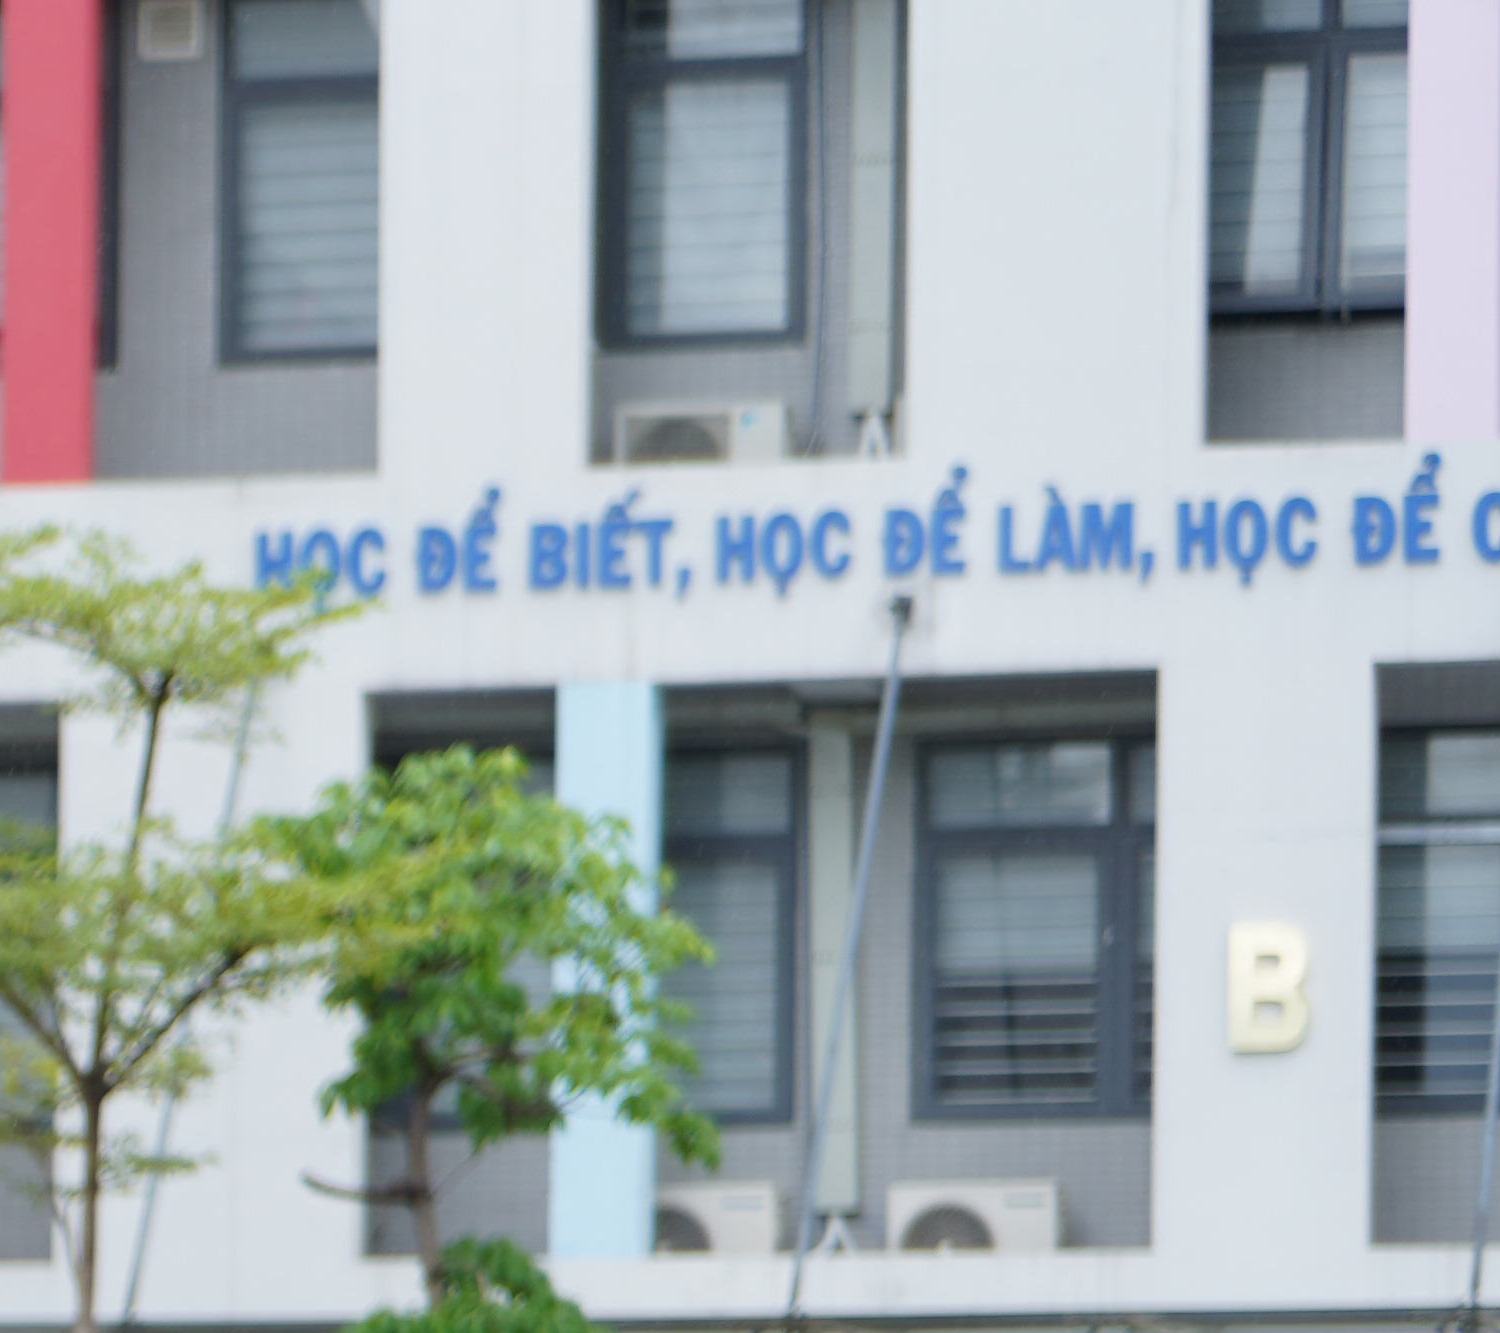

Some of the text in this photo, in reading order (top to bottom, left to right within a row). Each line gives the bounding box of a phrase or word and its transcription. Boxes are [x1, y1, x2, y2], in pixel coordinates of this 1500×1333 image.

[417, 487, 502, 593] ĐỂ
[529, 487, 692, 596] BIẾT,
[717, 509, 851, 595] HỌC
[882, 467, 967, 576] ĐỂ
[1000, 485, 1155, 586] LÀM,
[1177, 497, 1318, 586] HỌC
[1352, 452, 1441, 564] ĐỂ
[1228, 919, 1309, 1055] B
